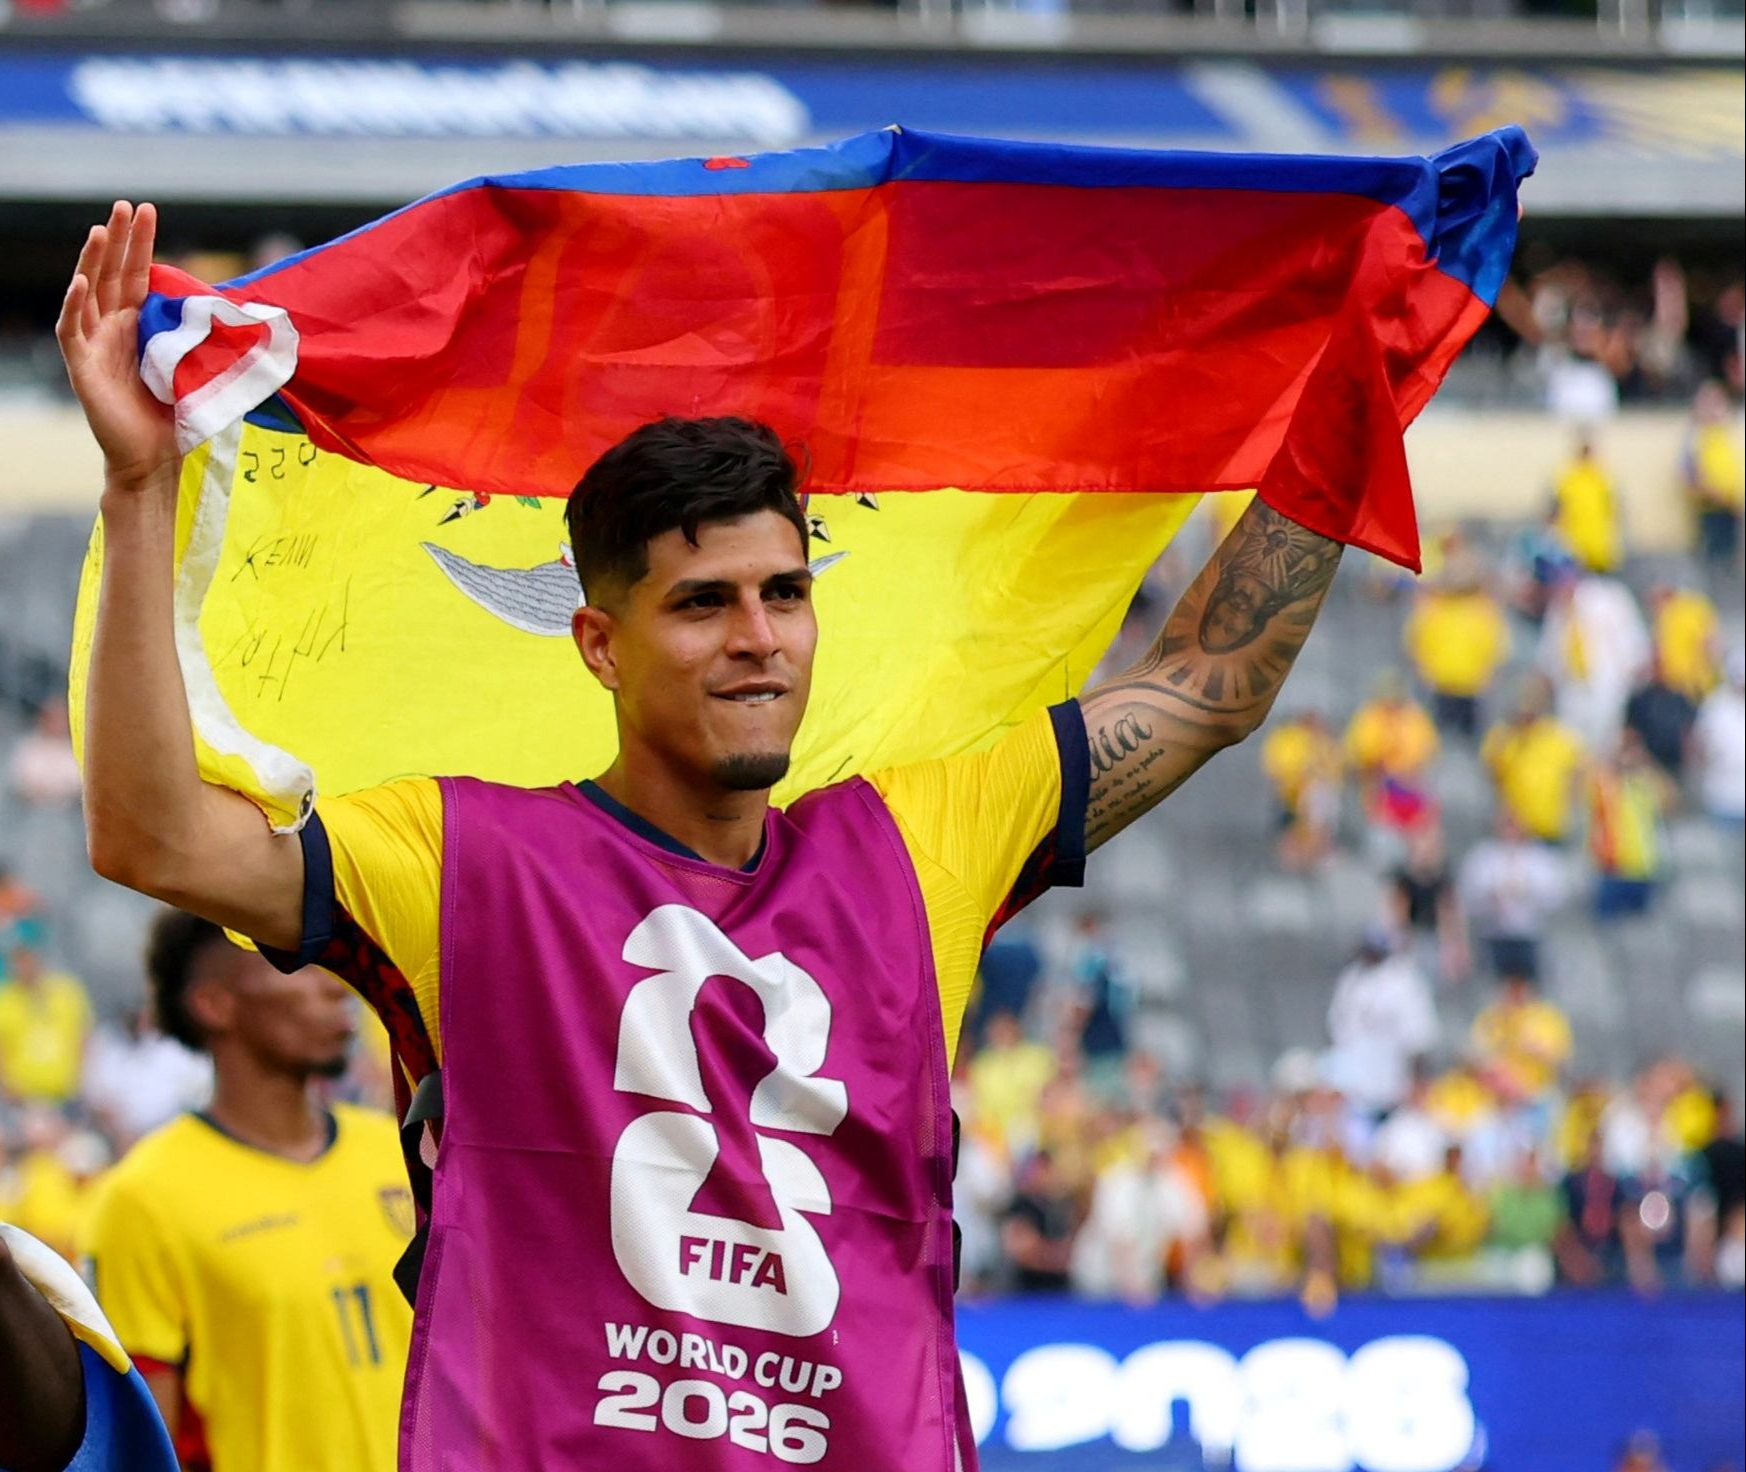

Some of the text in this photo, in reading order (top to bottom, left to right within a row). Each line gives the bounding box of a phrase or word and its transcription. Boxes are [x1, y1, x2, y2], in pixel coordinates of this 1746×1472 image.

[679, 1235, 788, 1296] FIFA
[605, 1322, 843, 1398] WORLD CUP
[593, 1369, 831, 1465] 2026
